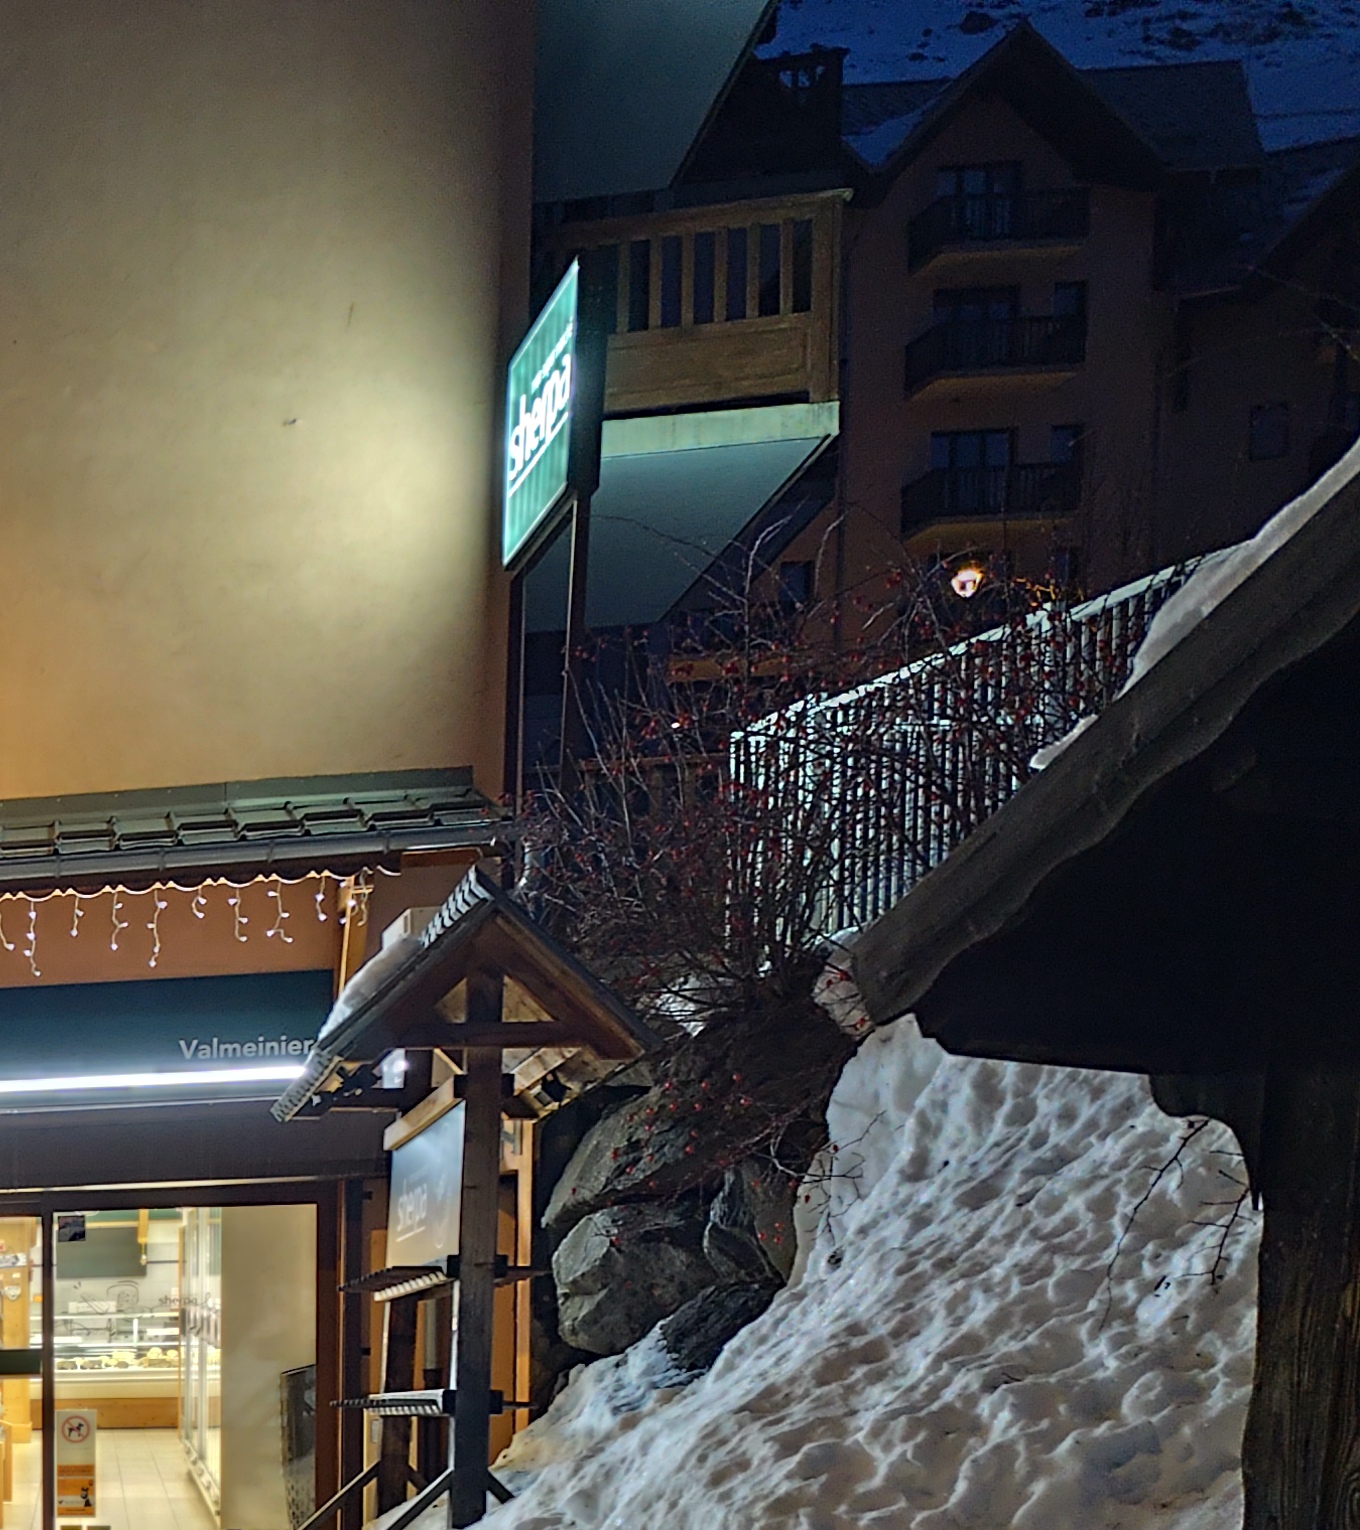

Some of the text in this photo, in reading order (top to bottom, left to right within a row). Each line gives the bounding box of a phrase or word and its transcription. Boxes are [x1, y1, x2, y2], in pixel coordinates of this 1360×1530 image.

[509, 354, 571, 480] sherpa
[178, 1035, 314, 1060] Valmeinier
[158, 1294, 198, 1306] shepa
